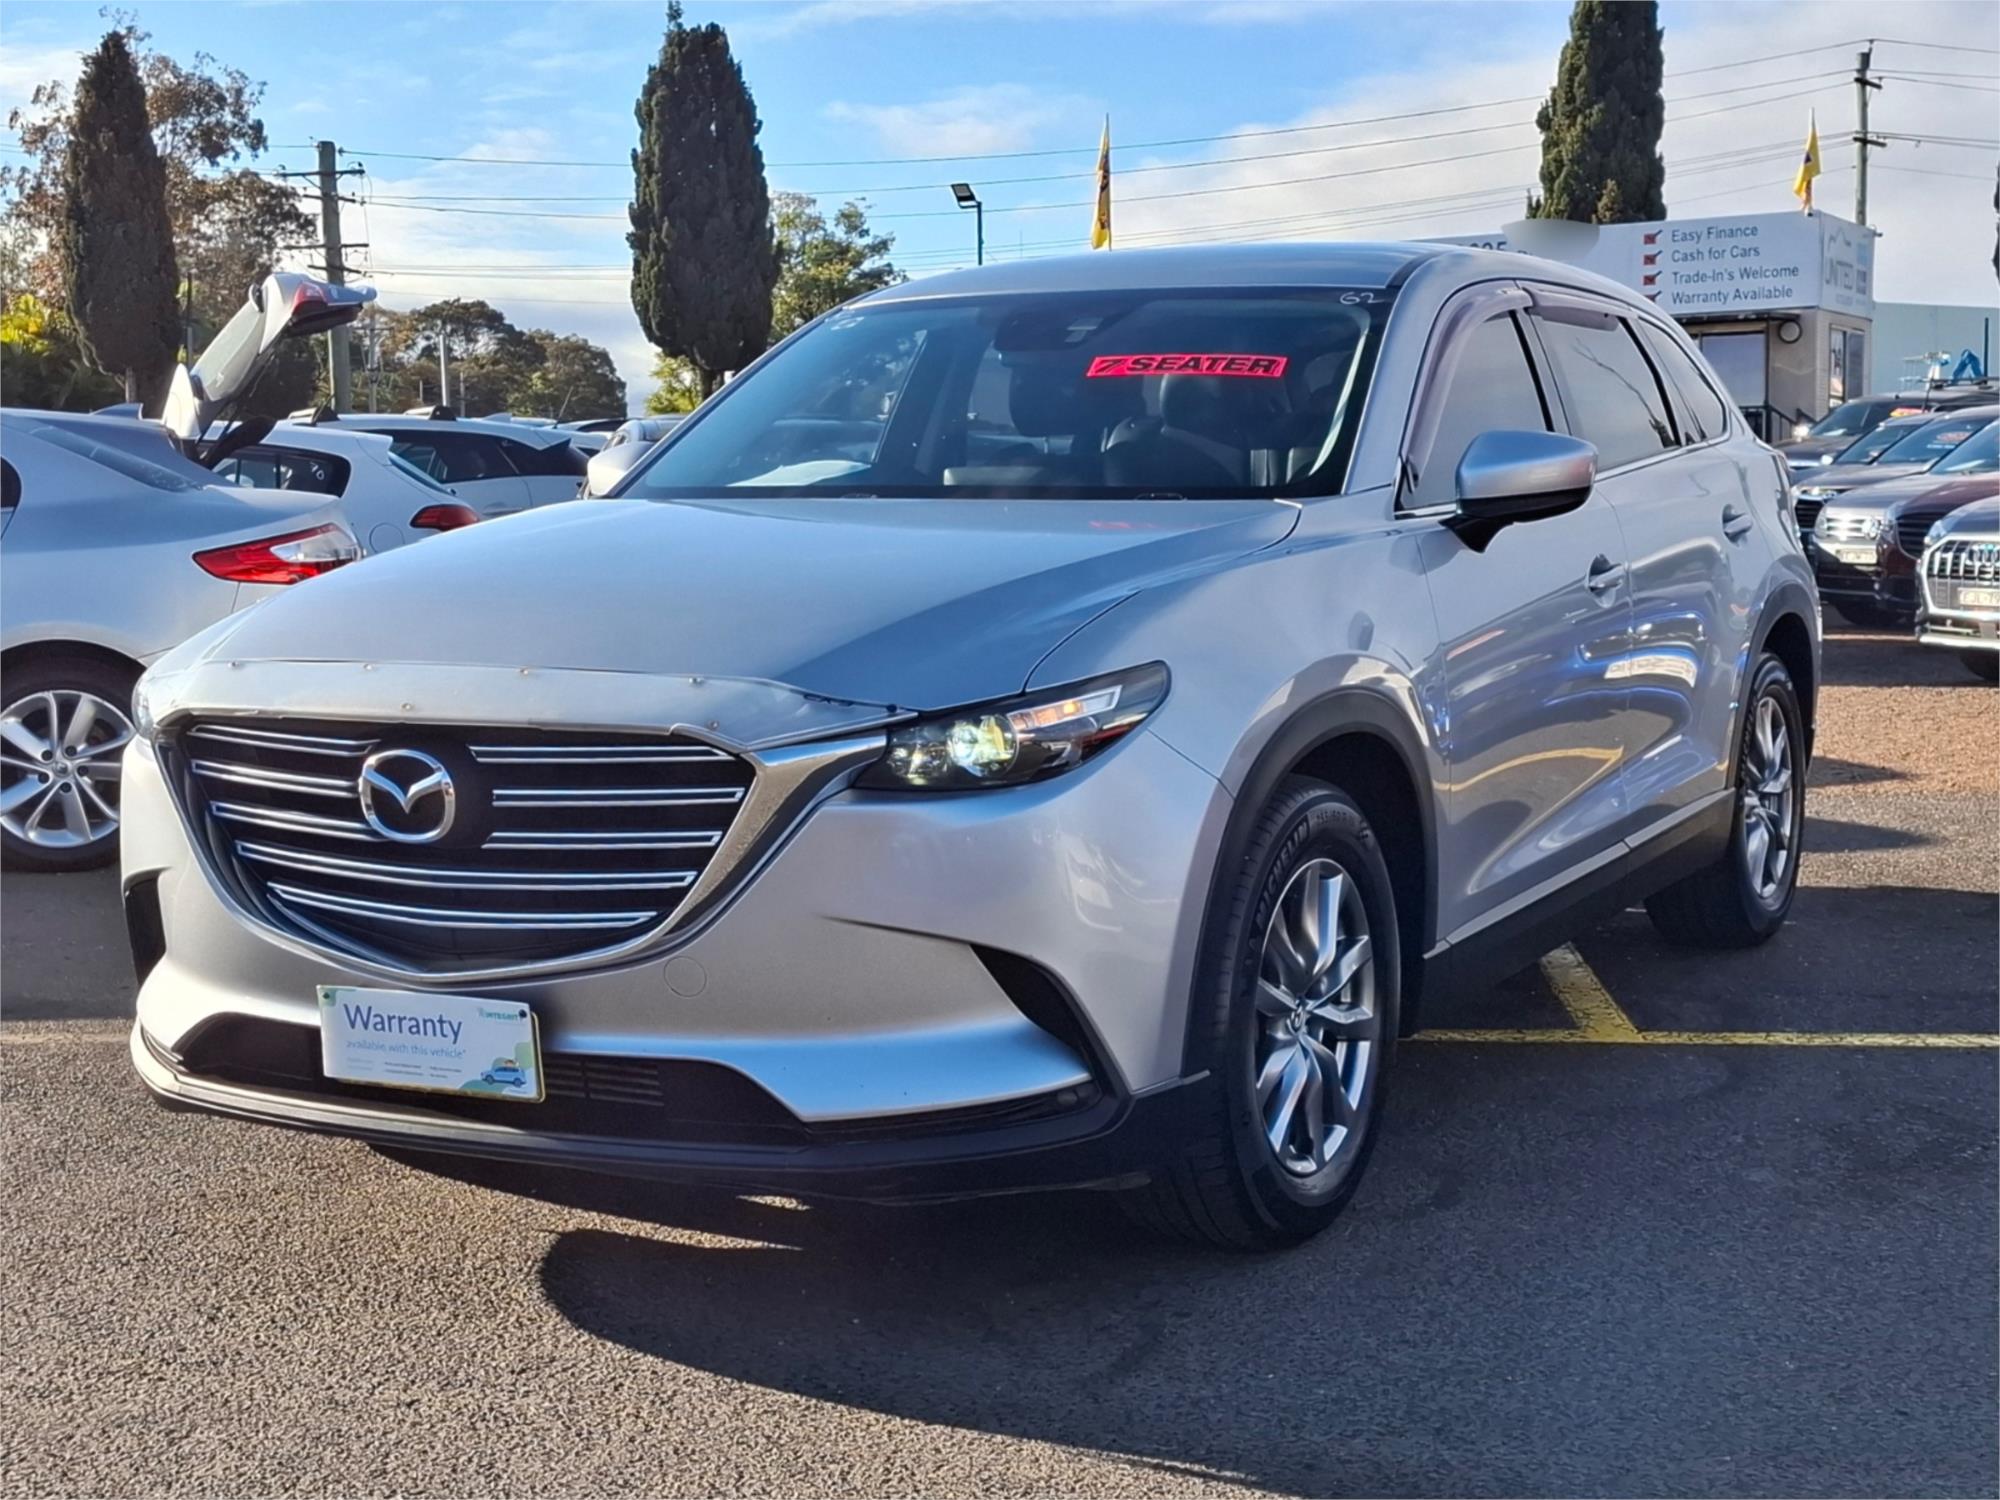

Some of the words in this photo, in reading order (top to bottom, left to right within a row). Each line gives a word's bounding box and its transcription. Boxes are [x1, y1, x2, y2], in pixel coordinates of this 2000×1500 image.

[1671, 228, 1702, 244] Easy
[1707, 226, 1758, 240] Finance
[1671, 249, 1704, 263] Cash
[1708, 247, 1726, 260] for
[1730, 245, 1760, 258] Cars
[1672, 268, 1735, 284] Trade-In's
[1739, 265, 1799, 280] Welcome
[1671, 289, 1729, 305] Warranty
[1732, 285, 1793, 301] Available
[1095, 358, 1126, 374] 7
[1127, 356, 1277, 373] SEATER
[344, 1003, 462, 1044] Warranty
[346, 1039, 385, 1052] available
[389, 1043, 409, 1053] with
[411, 1045, 428, 1056] this
